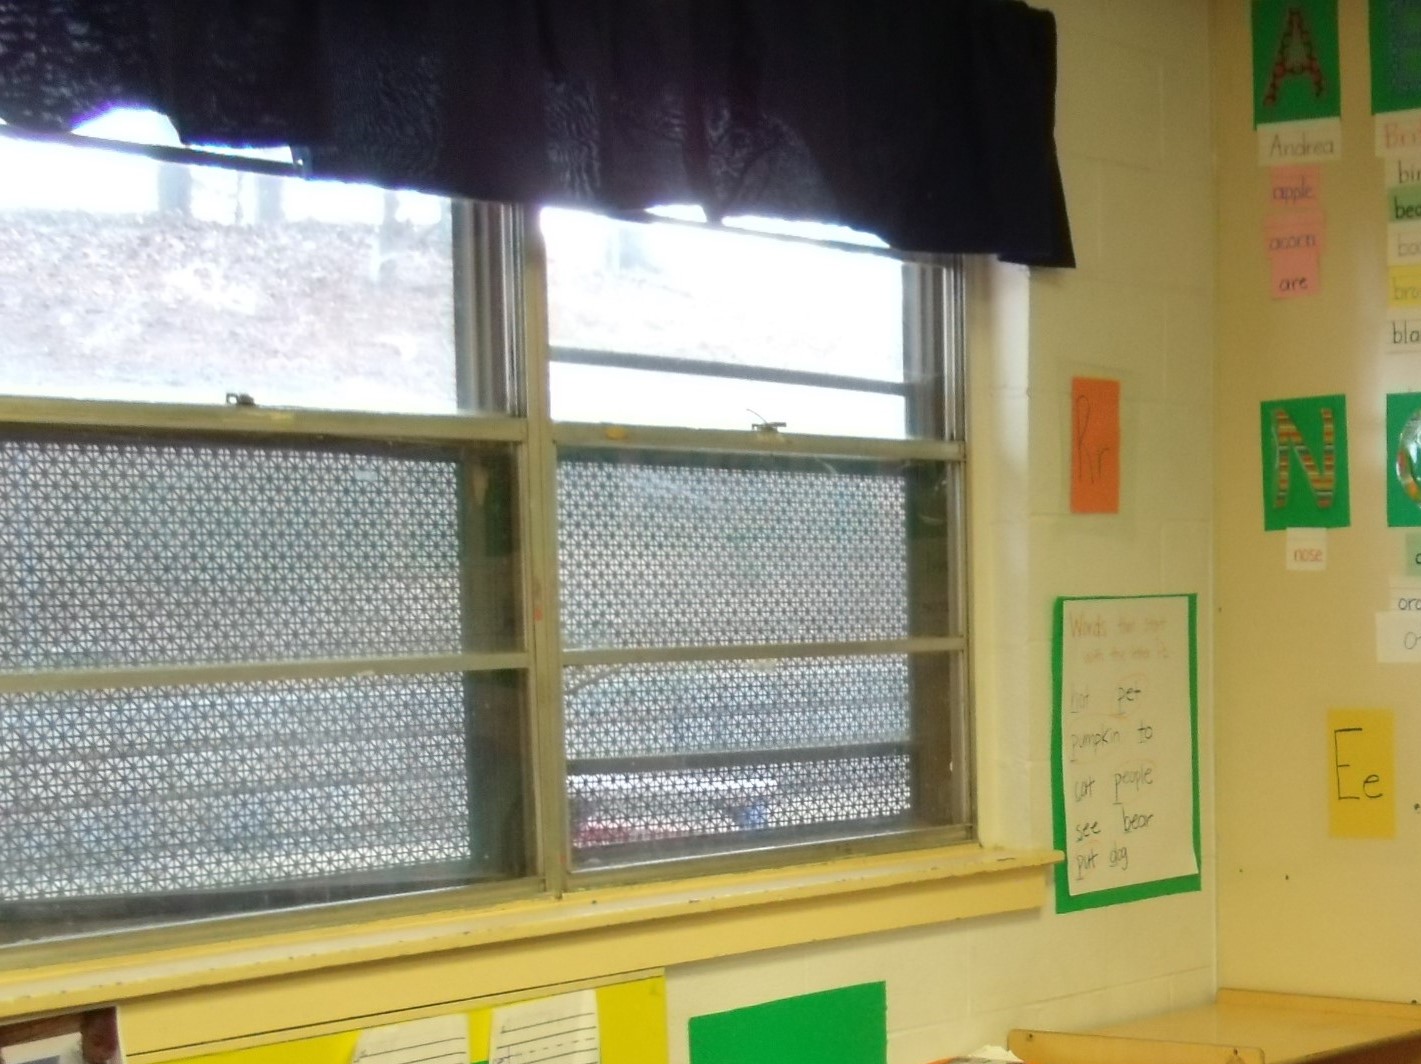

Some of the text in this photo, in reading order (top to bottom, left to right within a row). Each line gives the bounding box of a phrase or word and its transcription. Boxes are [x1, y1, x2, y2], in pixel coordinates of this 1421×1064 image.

[1263, 7, 1326, 106] A
[1269, 132, 1334, 157] Andrea
[1272, 176, 1313, 204] apple
[1279, 276, 1308, 292] are
[1272, 407, 1336, 510] N
[1070, 725, 1120, 758] pumpkin
[1333, 727, 1384, 801] Ee
[1113, 766, 1154, 803] people
[1075, 807, 1154, 841] see bear
[1109, 842, 1128, 871] dog
